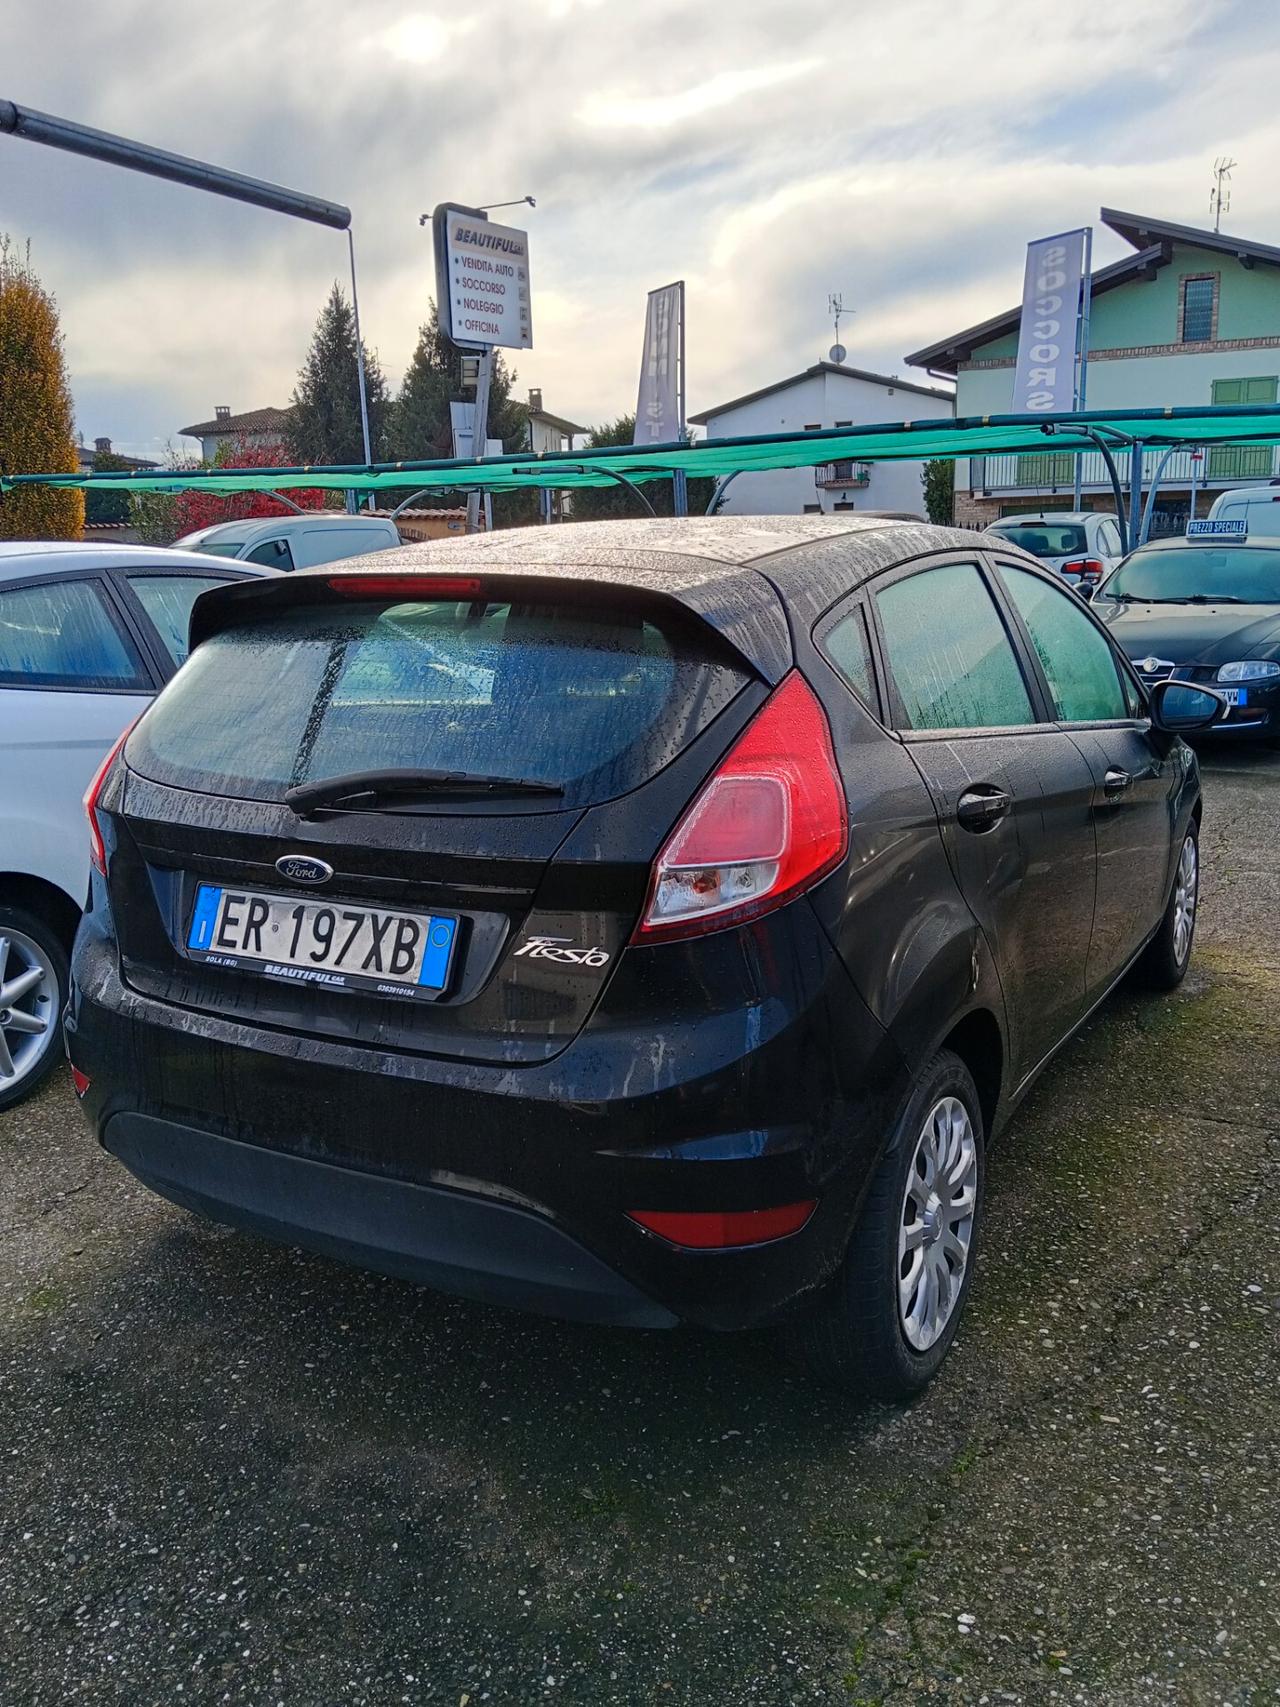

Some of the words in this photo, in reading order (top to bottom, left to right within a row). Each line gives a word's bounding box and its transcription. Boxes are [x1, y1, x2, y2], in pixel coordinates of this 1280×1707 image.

[455, 228, 515, 253] BEAUTIFUL
[461, 256, 493, 273] VENDITA
[495, 264, 514, 277] AUTO
[462, 277, 505, 295] SOCCORSO
[463, 298, 504, 315] NOLEGGIO
[465, 319, 500, 335] OFFICINA
[1190, 522, 1213, 533] PREZZO
[1214, 521, 1244, 533] SPECIALE
[286, 860, 318, 879] Ford
[217, 894, 270, 952] ER
[289, 904, 420, 975] 197XB
[513, 935, 610, 967] Fiesta
[264, 964, 331, 982] BEAUTIFUL
[331, 975, 345, 983] CAR
